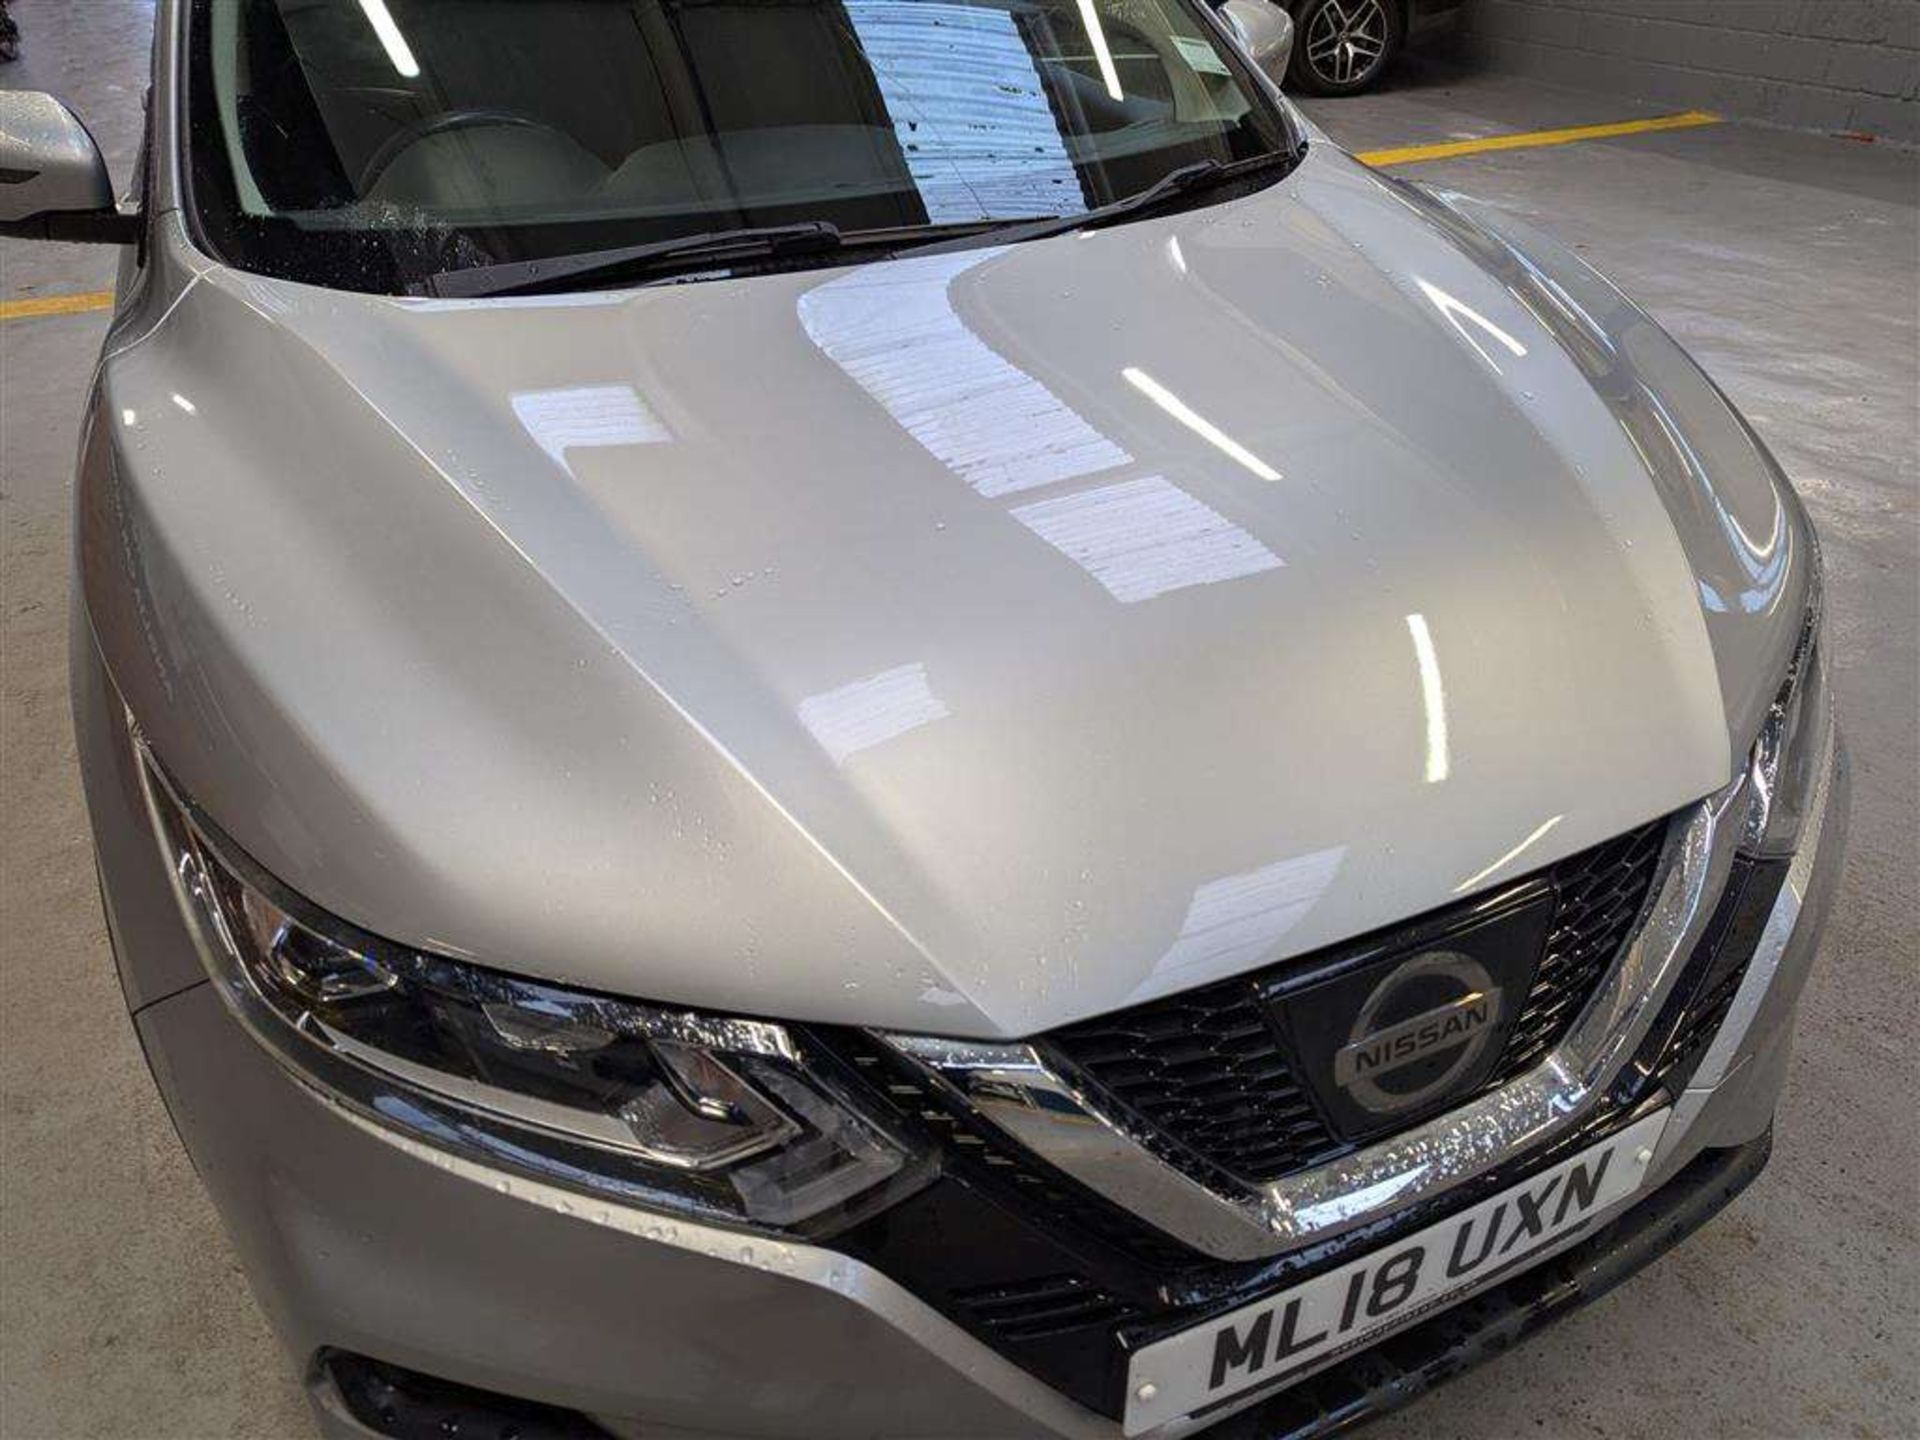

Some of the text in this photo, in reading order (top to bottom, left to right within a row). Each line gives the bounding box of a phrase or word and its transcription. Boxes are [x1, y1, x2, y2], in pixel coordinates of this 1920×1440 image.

[1356, 1003, 1488, 1072] NISSAN
[1208, 1246, 1426, 1391] ML18
[1446, 1147, 1615, 1279] UXN
